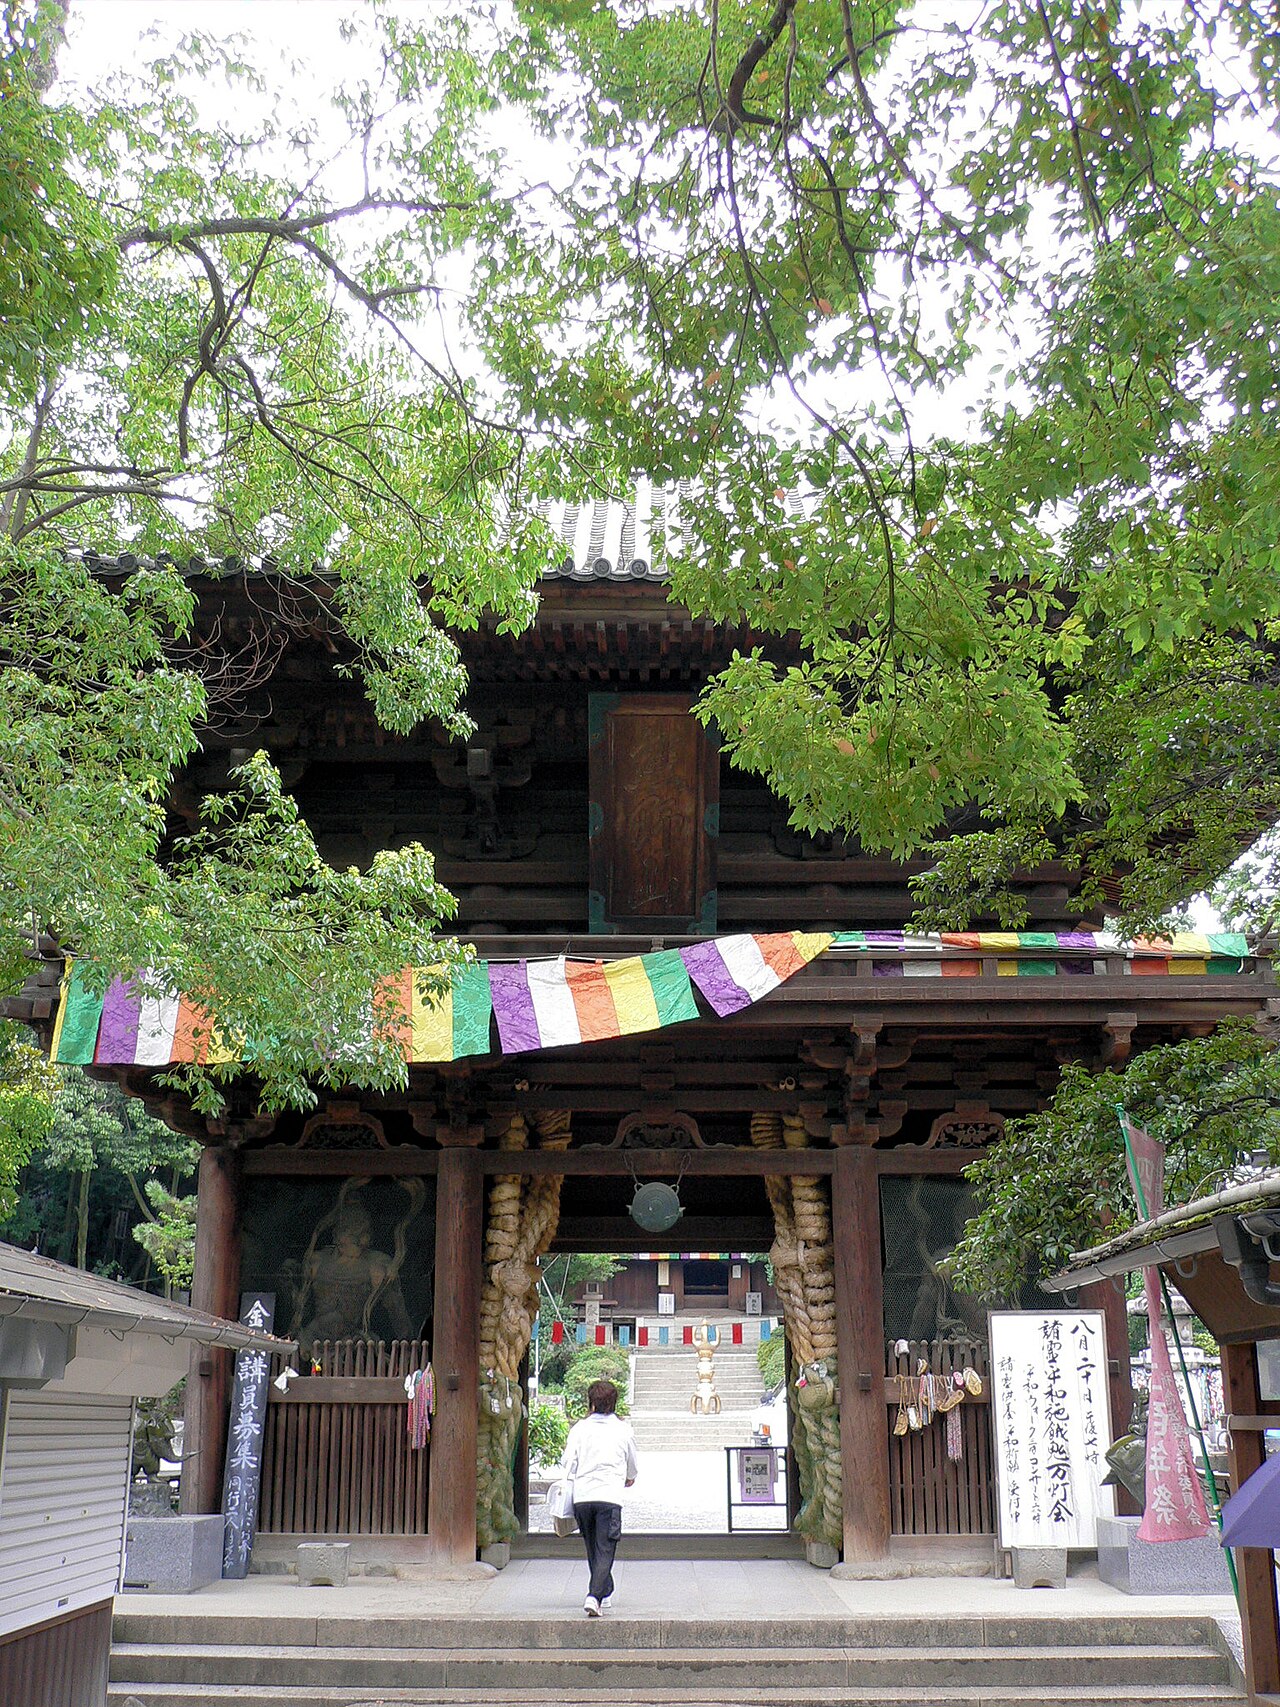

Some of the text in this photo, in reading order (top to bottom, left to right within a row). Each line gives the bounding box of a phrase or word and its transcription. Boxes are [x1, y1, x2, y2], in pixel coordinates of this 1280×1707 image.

[230, 1300, 271, 1469] 金講員募集
